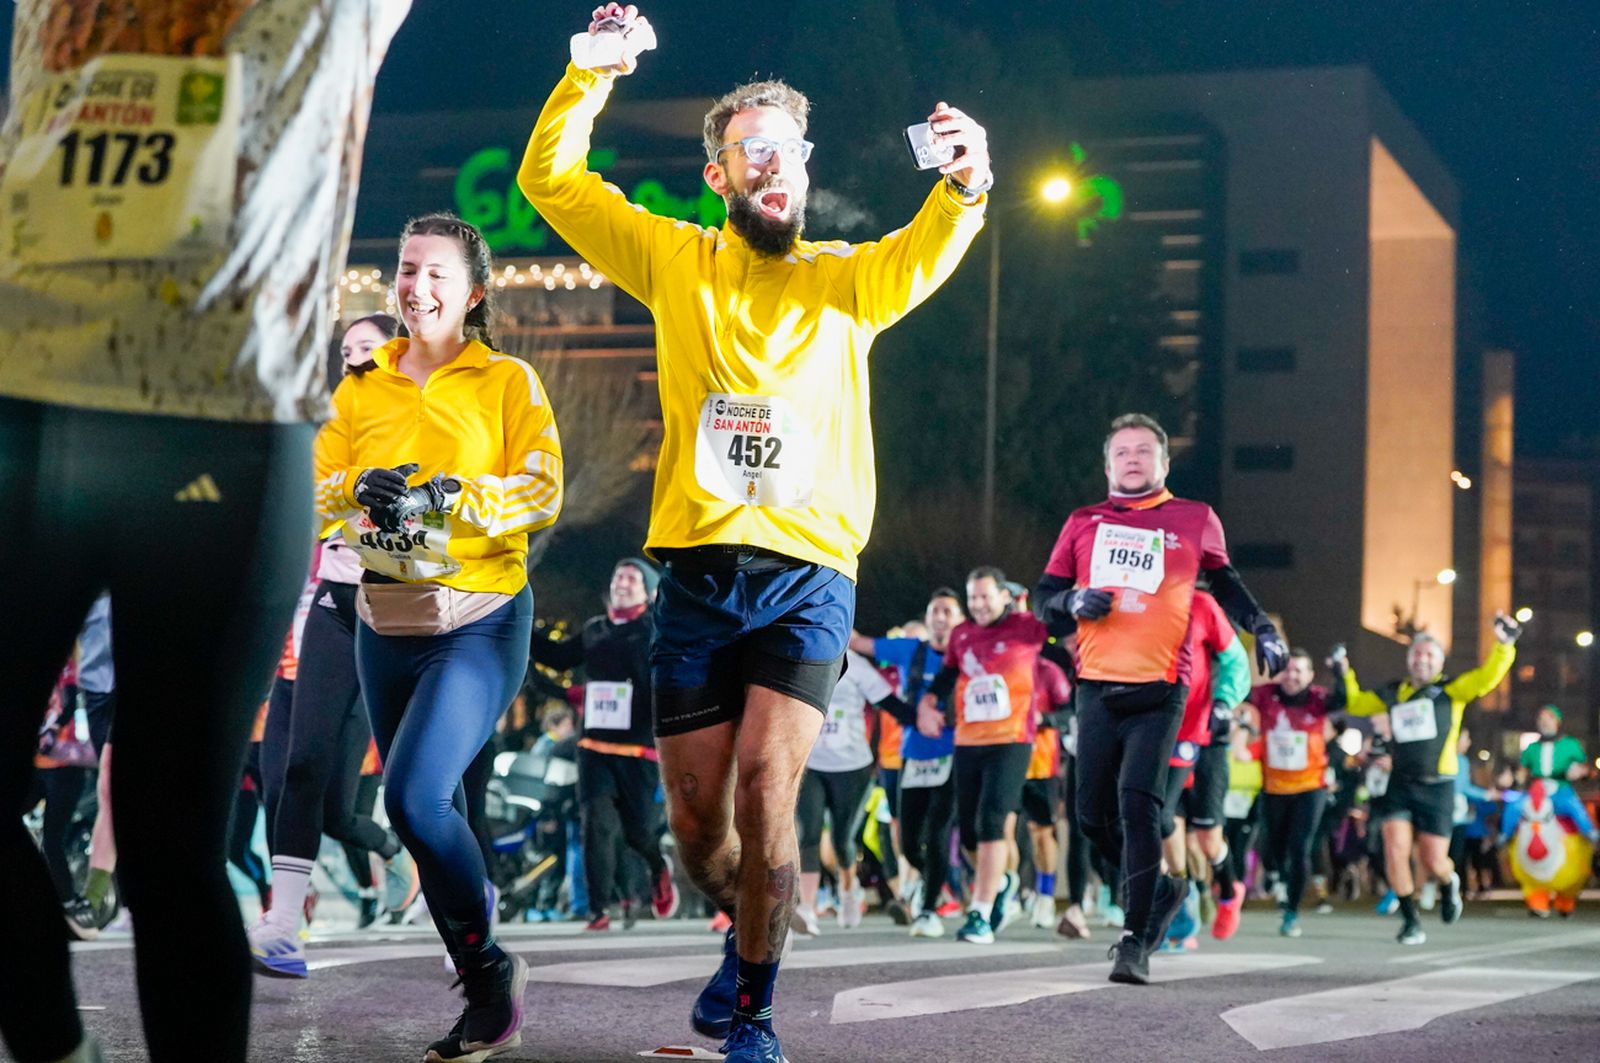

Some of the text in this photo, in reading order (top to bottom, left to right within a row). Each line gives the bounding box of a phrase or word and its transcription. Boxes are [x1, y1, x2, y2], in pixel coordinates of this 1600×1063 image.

[60, 131, 175, 186] 1173
[727, 406, 771, 419] NOCHE DE
[713, 418, 771, 433] SAN ANTÓN
[728, 434, 782, 469] 452
[1109, 548, 1154, 570] 1958
